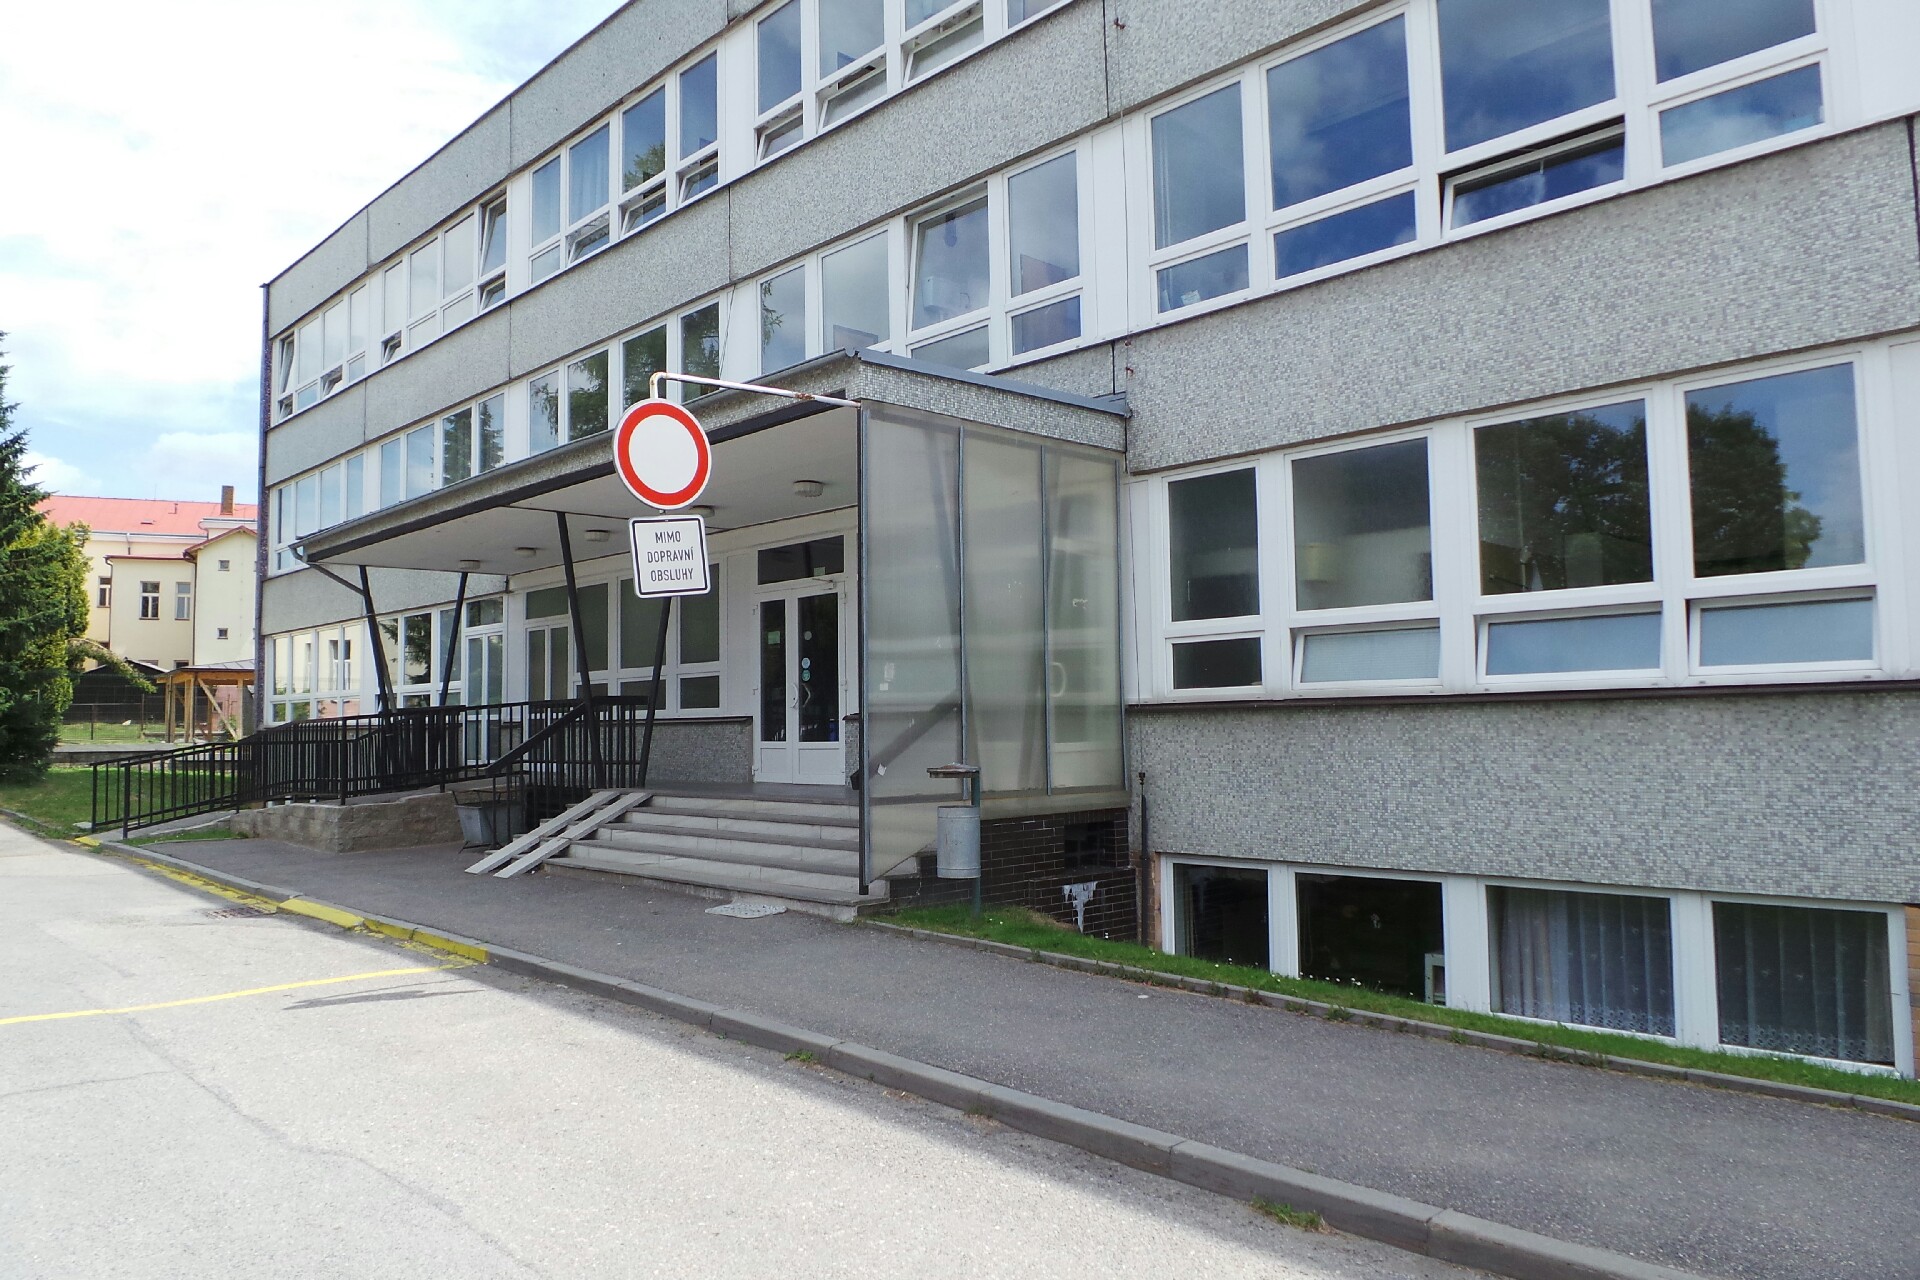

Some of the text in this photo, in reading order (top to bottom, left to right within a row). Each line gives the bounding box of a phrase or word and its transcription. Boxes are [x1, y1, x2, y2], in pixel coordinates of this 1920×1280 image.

[655, 531, 681, 543] MIMO
[647, 546, 694, 563] DOPRAVNÍ
[650, 568, 694, 582] OBSLUHY
